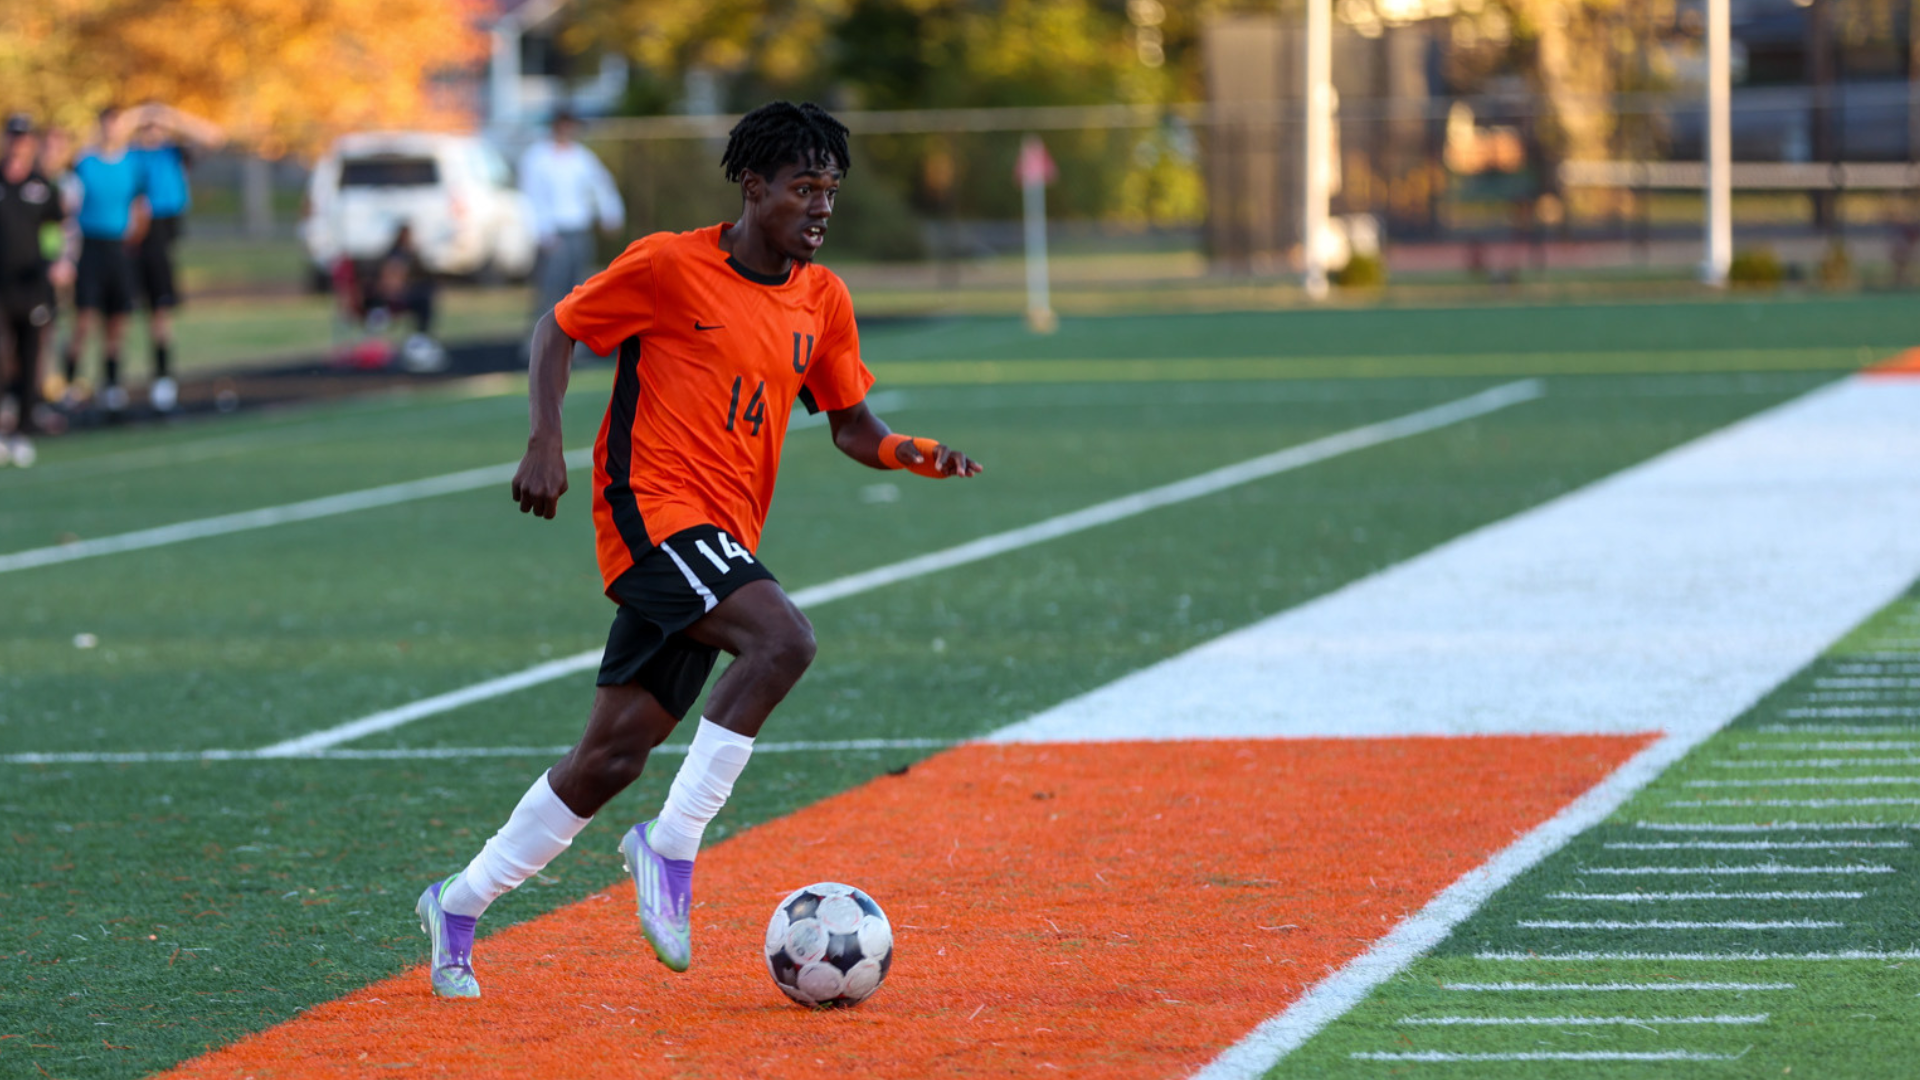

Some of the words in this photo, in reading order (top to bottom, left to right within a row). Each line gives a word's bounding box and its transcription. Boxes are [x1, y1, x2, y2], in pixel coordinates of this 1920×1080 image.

[793, 331, 814, 374] U
[726, 375, 765, 436] 14
[694, 532, 754, 575] 14
